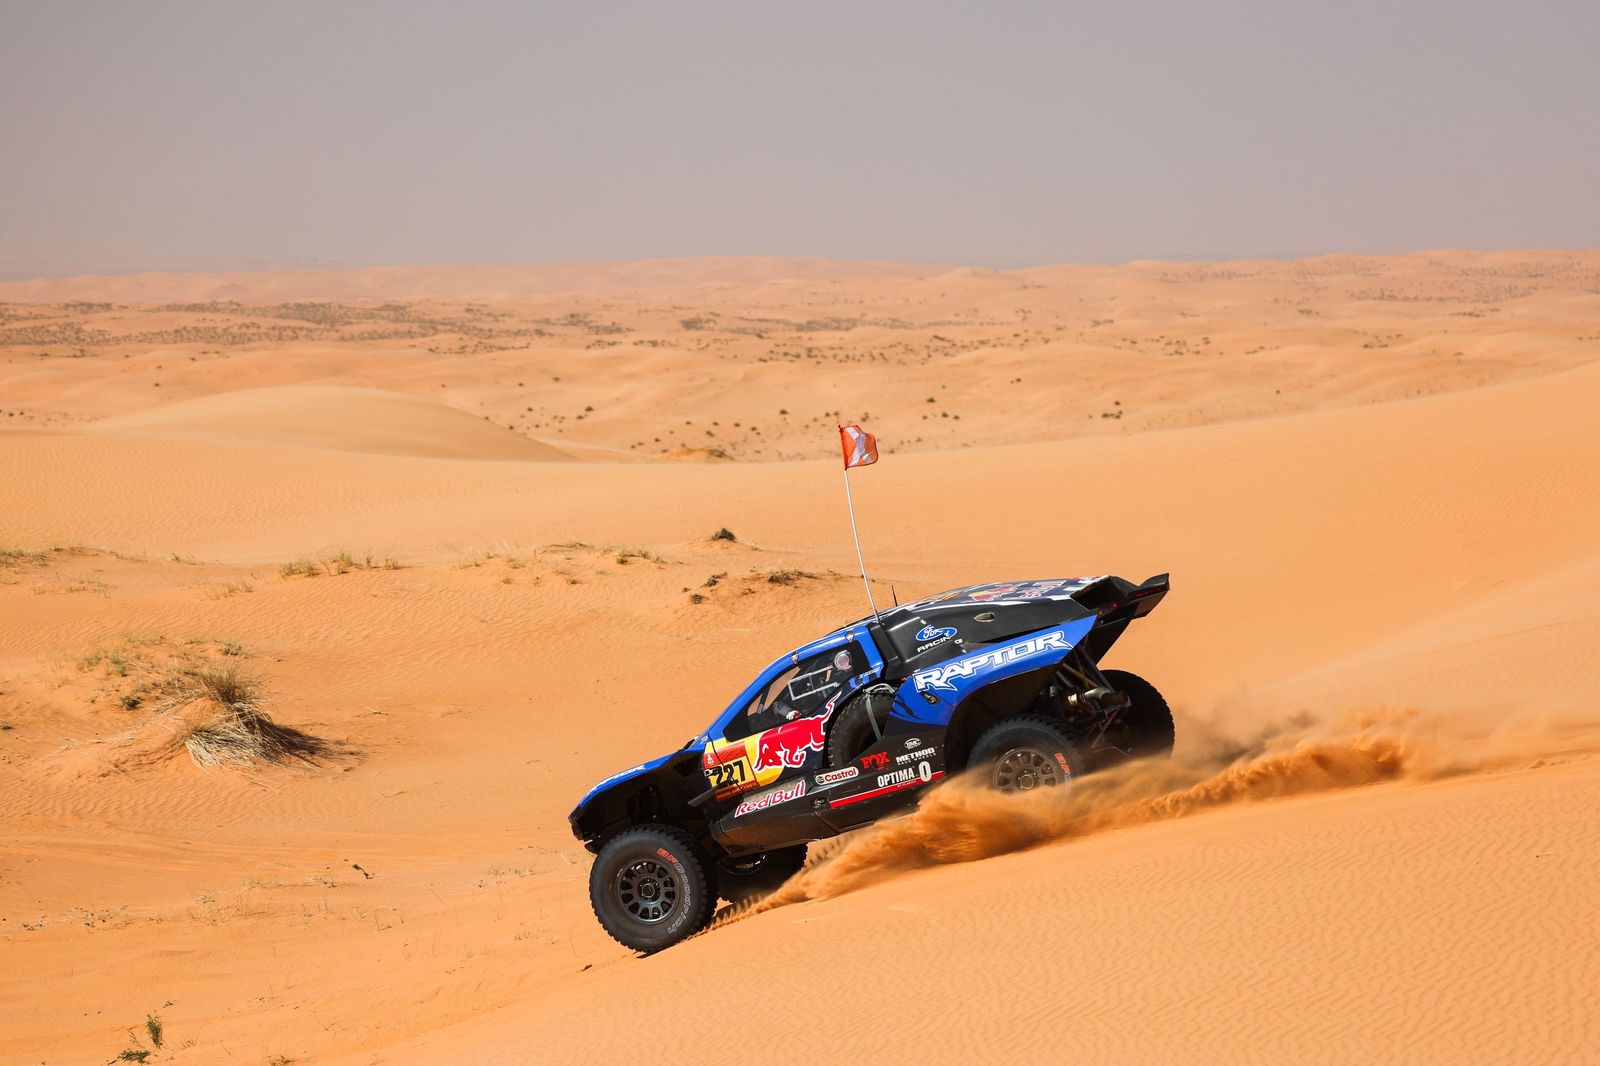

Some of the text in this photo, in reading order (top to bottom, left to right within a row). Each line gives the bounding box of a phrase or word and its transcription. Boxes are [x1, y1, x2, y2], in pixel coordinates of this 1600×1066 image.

[921, 624, 951, 639] Ford
[912, 630, 1074, 692] RAPTOR
[860, 751, 891, 769] FOX
[895, 747, 936, 763] METHOD
[711, 760, 746, 789] 227
[824, 767, 857, 782] Castrol
[877, 767, 915, 788] OPTIMA
[734, 795, 771, 818] Red
[769, 779, 806, 805] Bull
